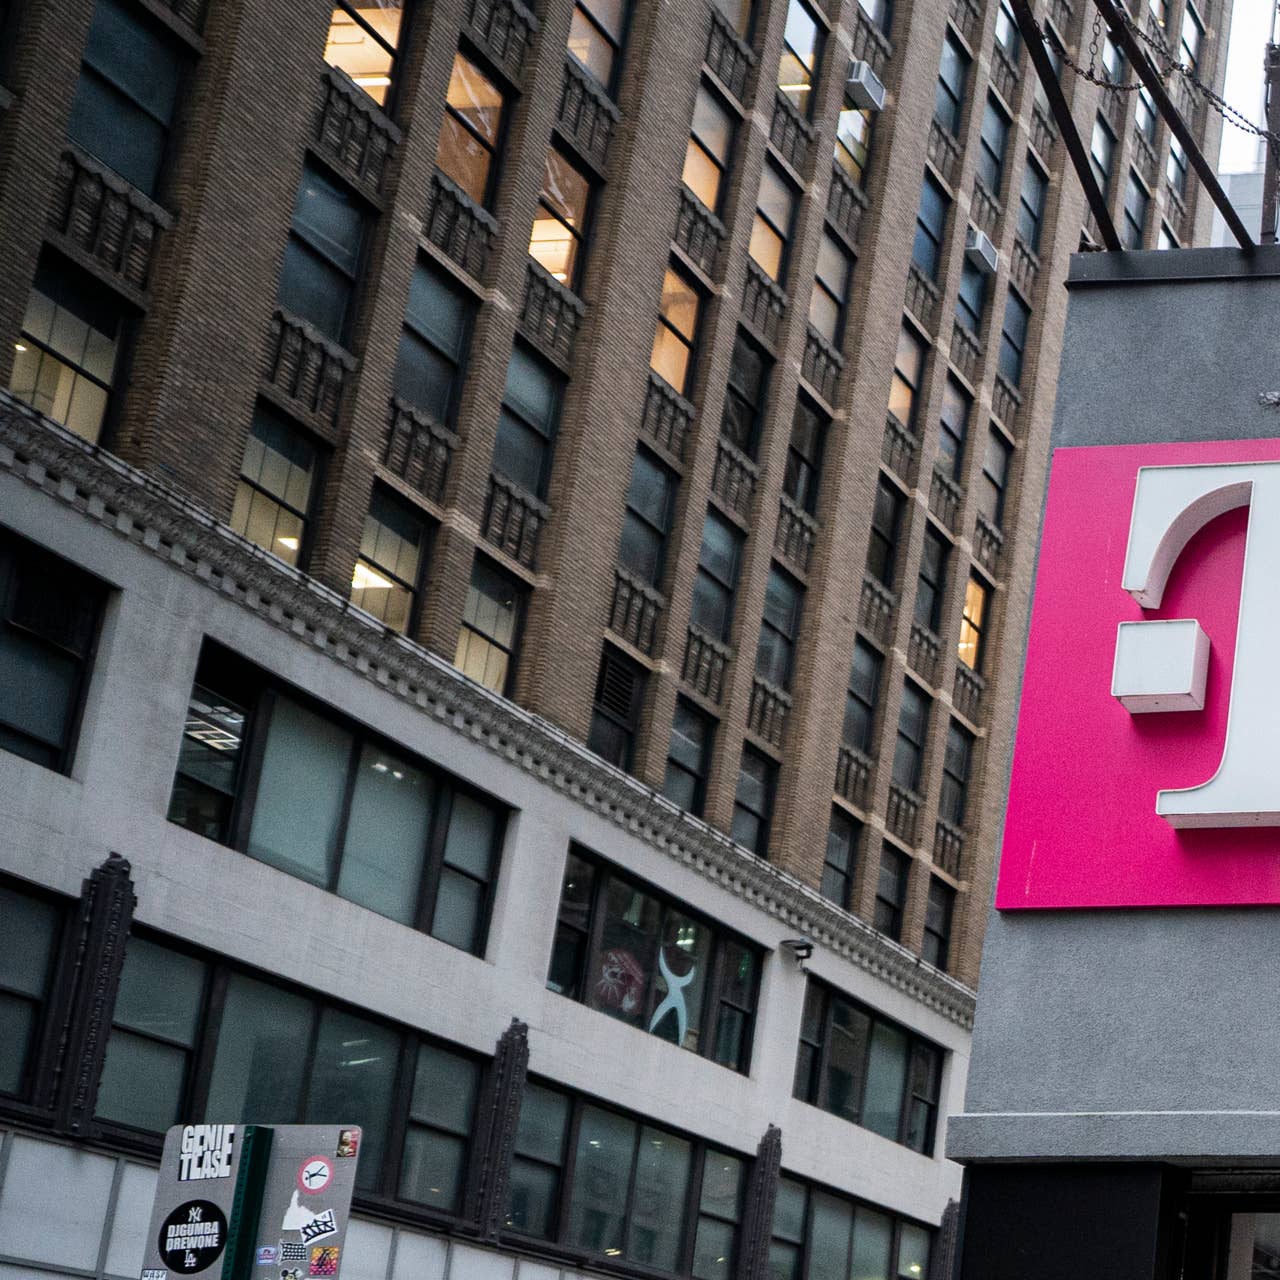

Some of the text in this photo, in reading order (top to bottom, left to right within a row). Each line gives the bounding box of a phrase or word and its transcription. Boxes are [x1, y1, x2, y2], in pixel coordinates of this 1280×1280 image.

[182, 1124, 236, 1154] GENIE
[179, 1150, 232, 1181] TEASE
[165, 1234, 219, 1252] DREWONE
